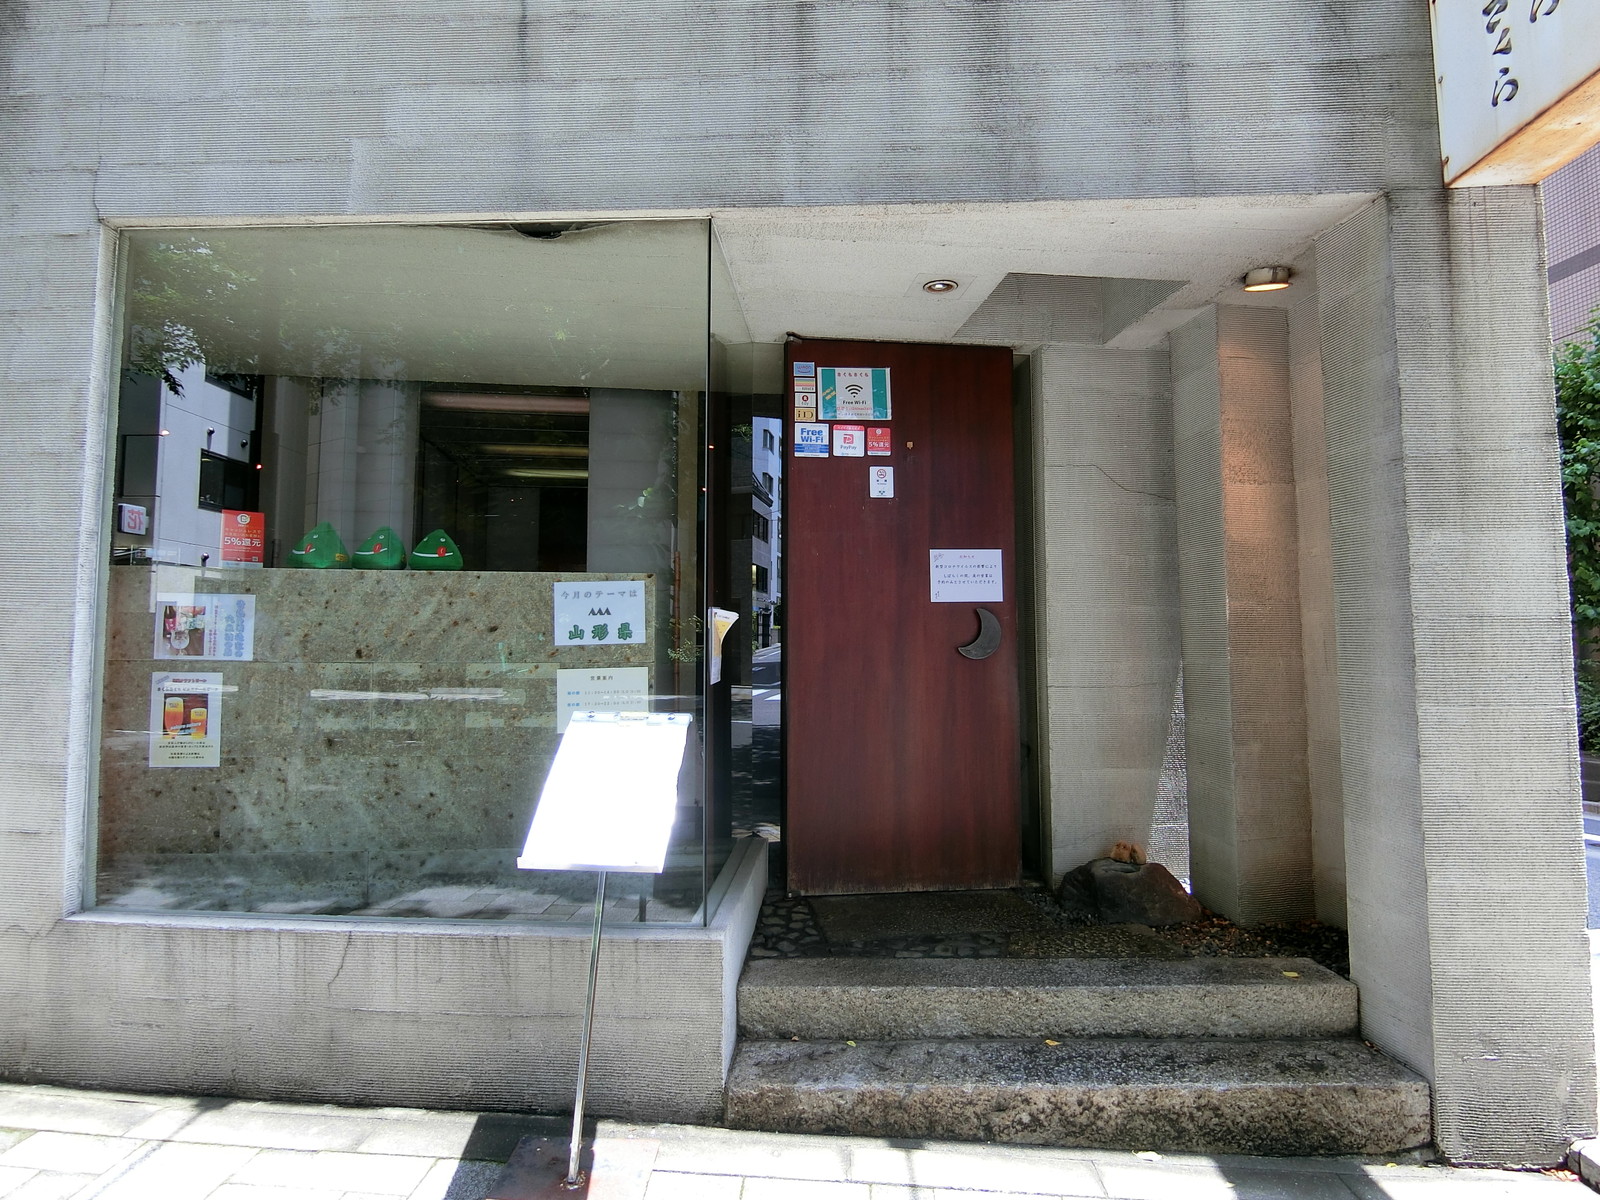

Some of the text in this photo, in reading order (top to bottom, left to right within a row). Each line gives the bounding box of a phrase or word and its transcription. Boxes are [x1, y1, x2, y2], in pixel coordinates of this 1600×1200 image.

[800, 428, 823, 436] Free
[224, 536, 262, 547] 5%還元
[561, 589, 638, 600] 今月のテーマは
[568, 622, 633, 641] 山形県
